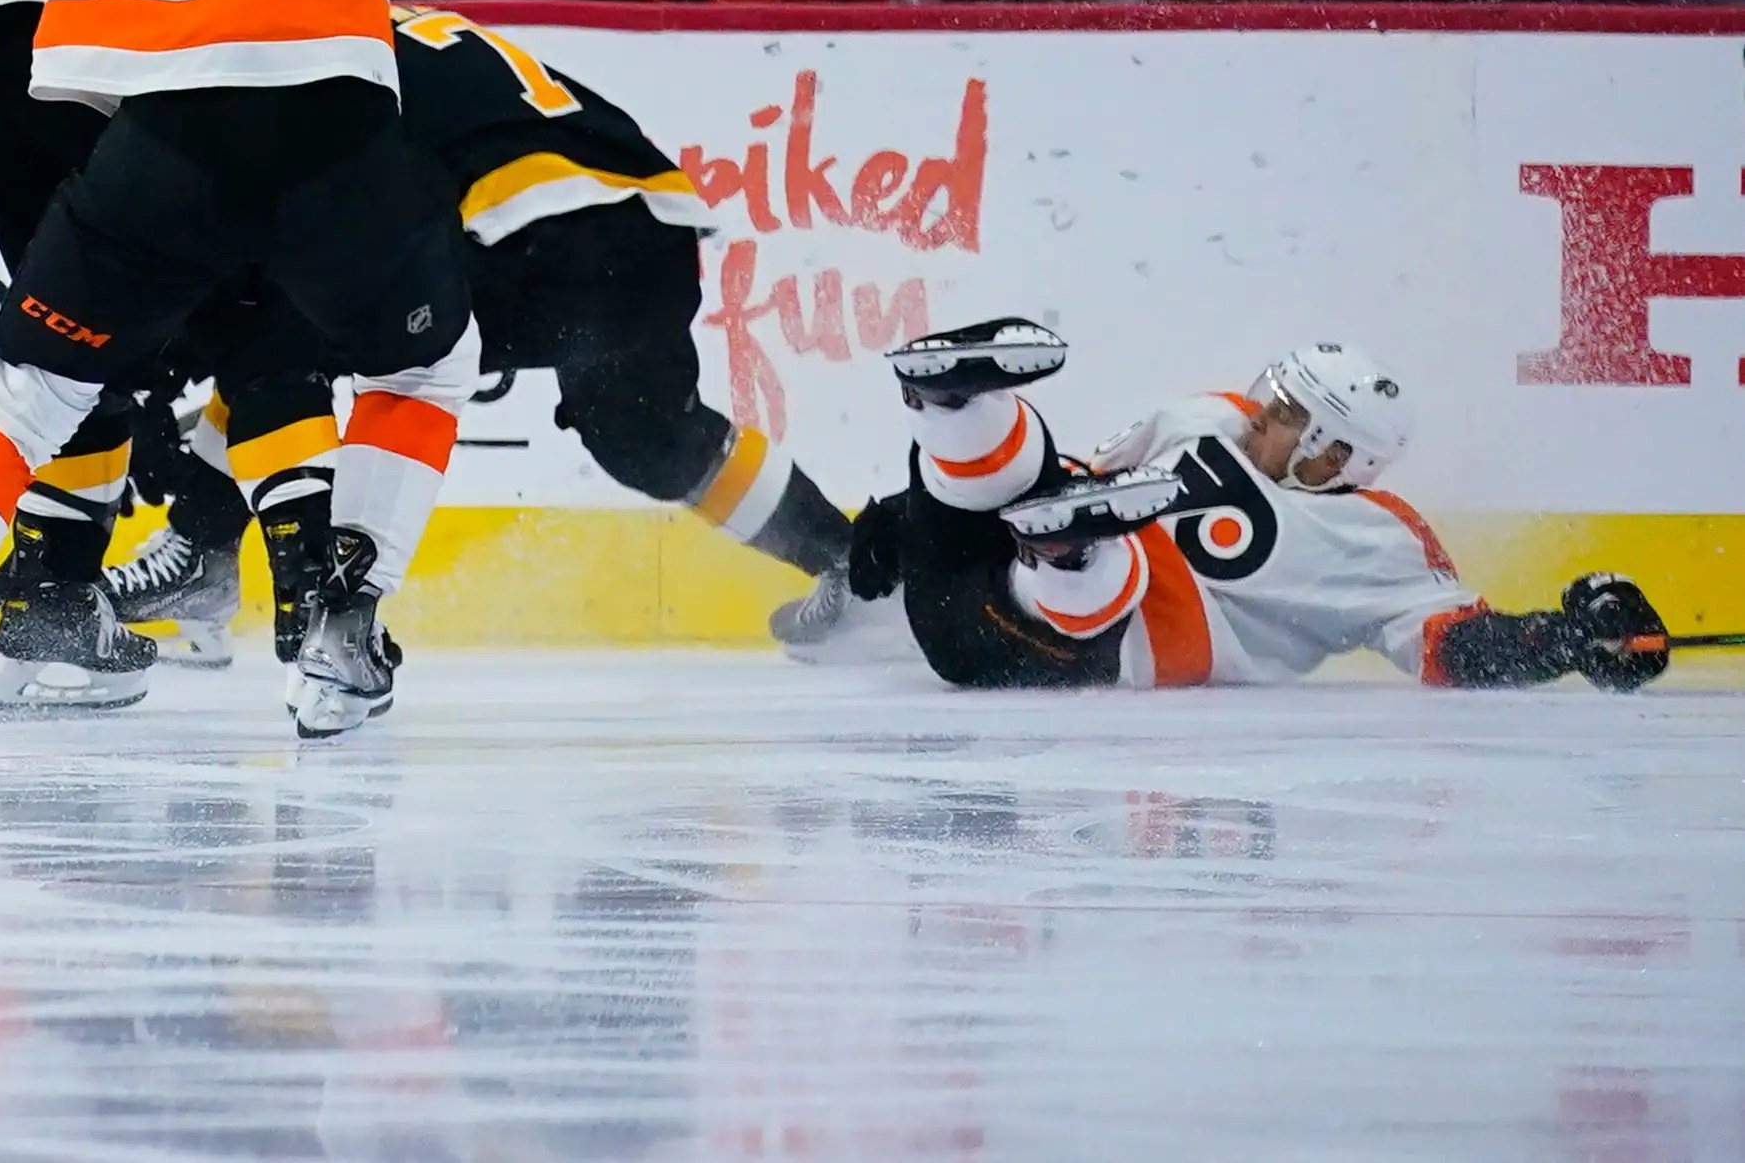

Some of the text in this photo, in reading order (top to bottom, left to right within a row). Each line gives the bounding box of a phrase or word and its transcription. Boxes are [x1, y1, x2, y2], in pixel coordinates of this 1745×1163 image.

[396, 10, 584, 119] 7
[20, 294, 112, 349] CCM
[702, 239, 931, 444] fun
